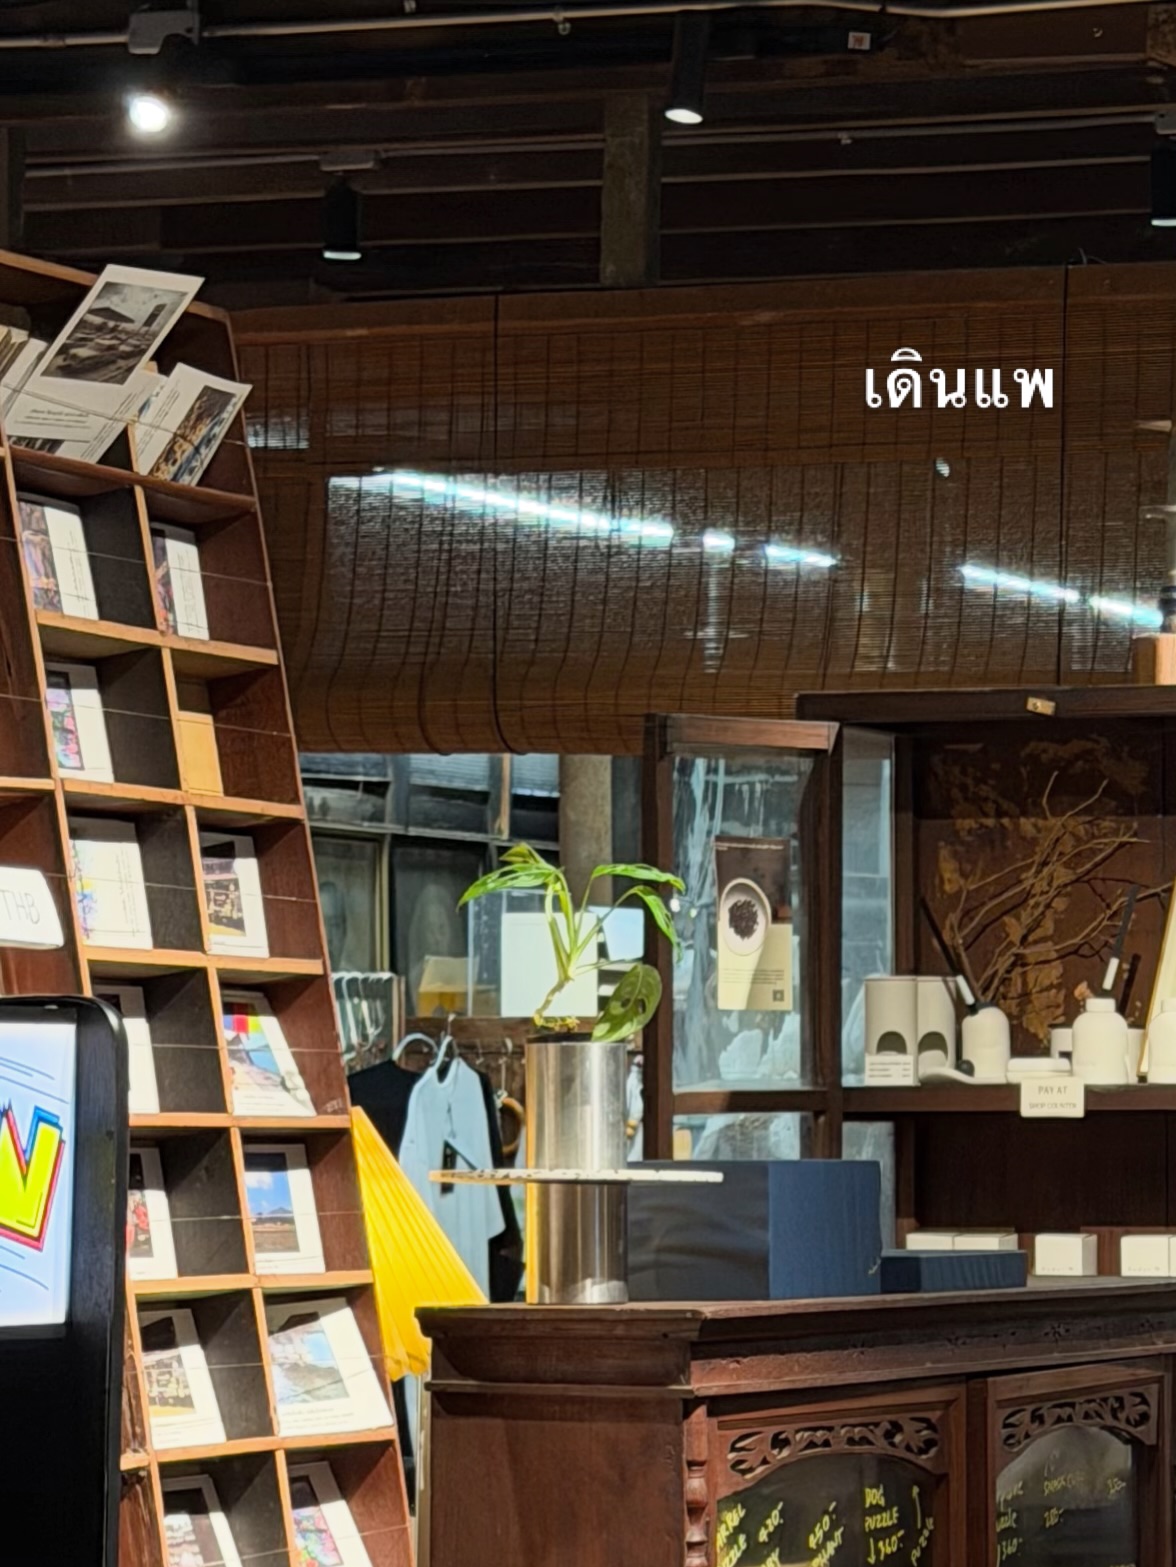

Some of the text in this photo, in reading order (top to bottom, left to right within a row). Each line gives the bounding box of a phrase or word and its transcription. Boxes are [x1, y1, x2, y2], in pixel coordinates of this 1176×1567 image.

[1038, 1086, 1054, 1095] PAY
[864, 1483, 885, 1508] DOG
[864, 1506, 899, 1532] PUZZLE
